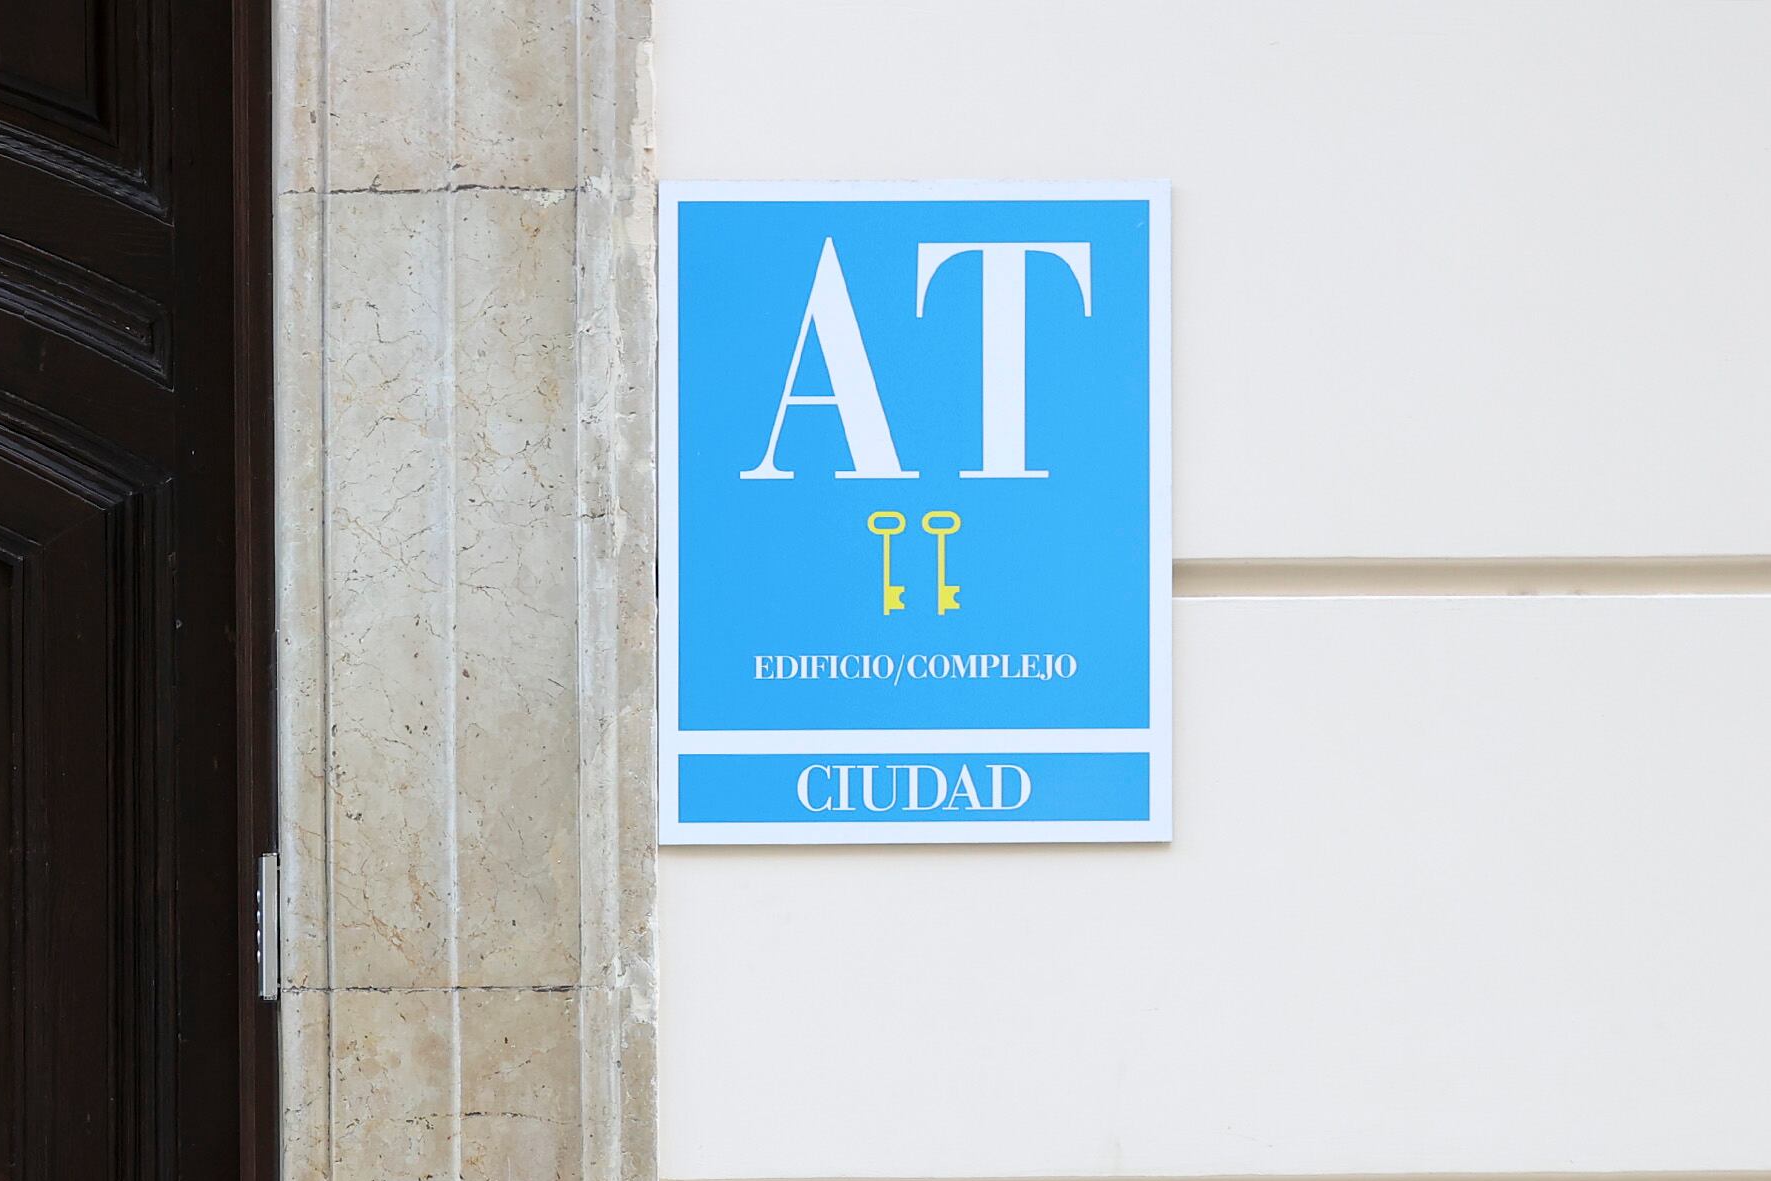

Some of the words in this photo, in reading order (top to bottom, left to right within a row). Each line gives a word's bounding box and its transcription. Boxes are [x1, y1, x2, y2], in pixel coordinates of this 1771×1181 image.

[740, 236, 1092, 480] AT
[754, 654, 1078, 686] EDIFICIO/COMPLEJO
[797, 764, 1032, 812] CIUDAD
